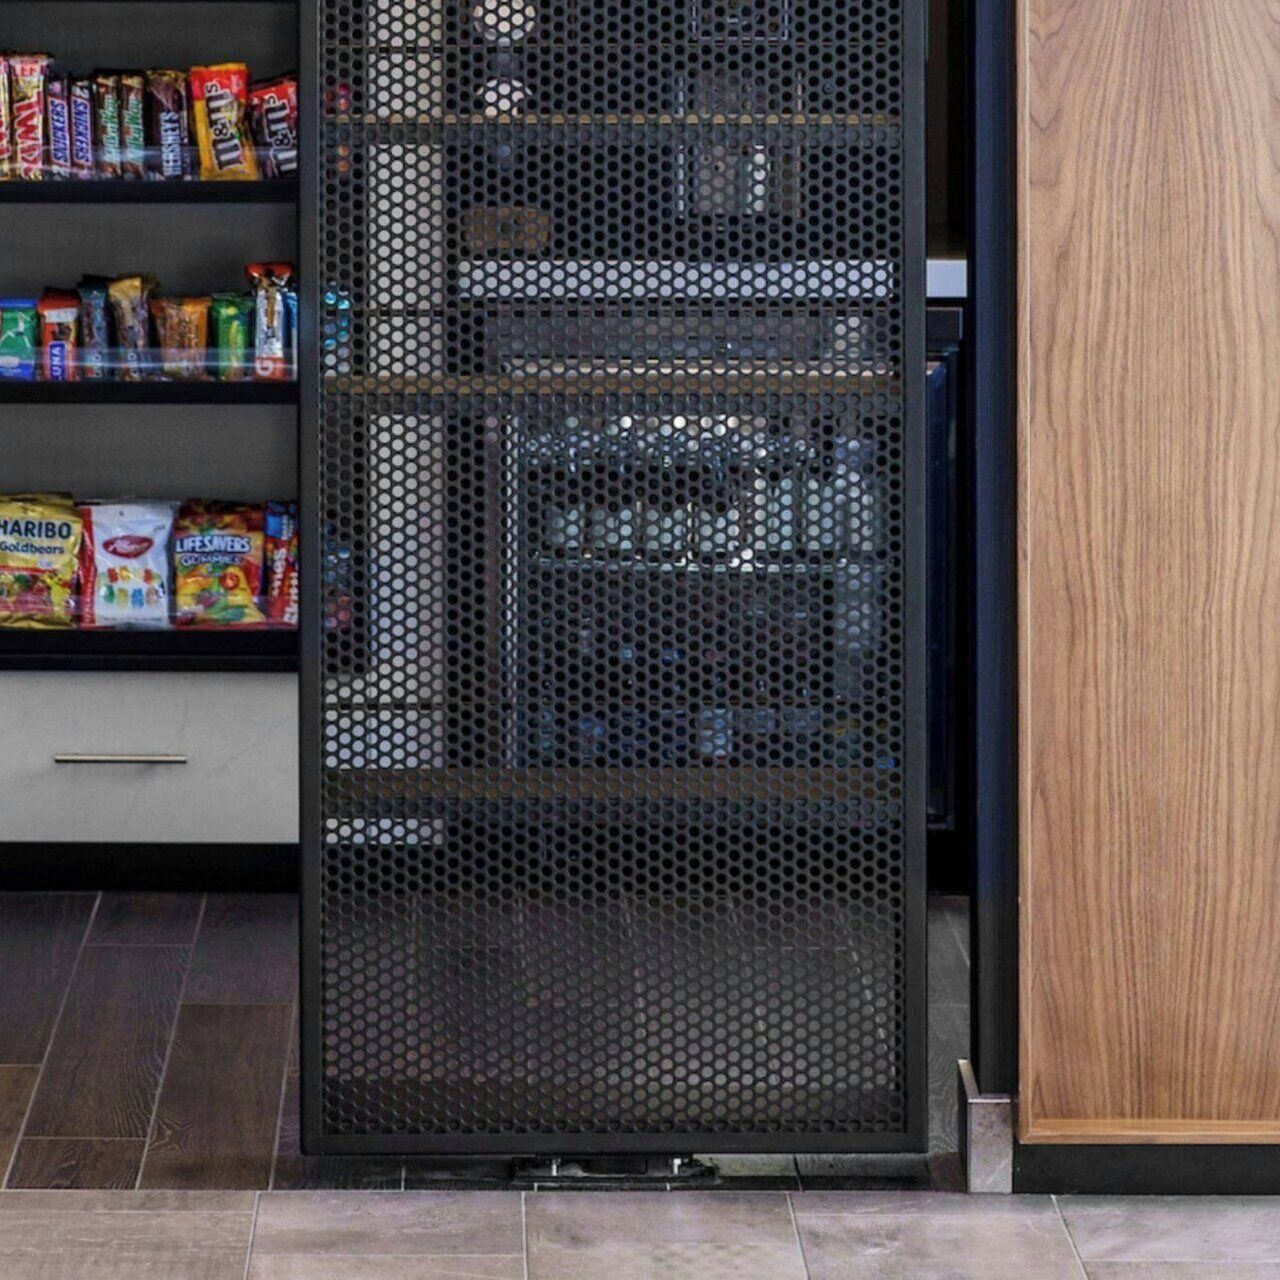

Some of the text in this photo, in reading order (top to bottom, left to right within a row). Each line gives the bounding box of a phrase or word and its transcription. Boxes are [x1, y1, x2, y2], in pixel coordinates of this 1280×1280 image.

[13, 89, 43, 179] TWIX
[50, 98, 70, 164] SNICKERS
[72, 99, 91, 164] SNICKERS
[52, 346, 64, 380] UNA
